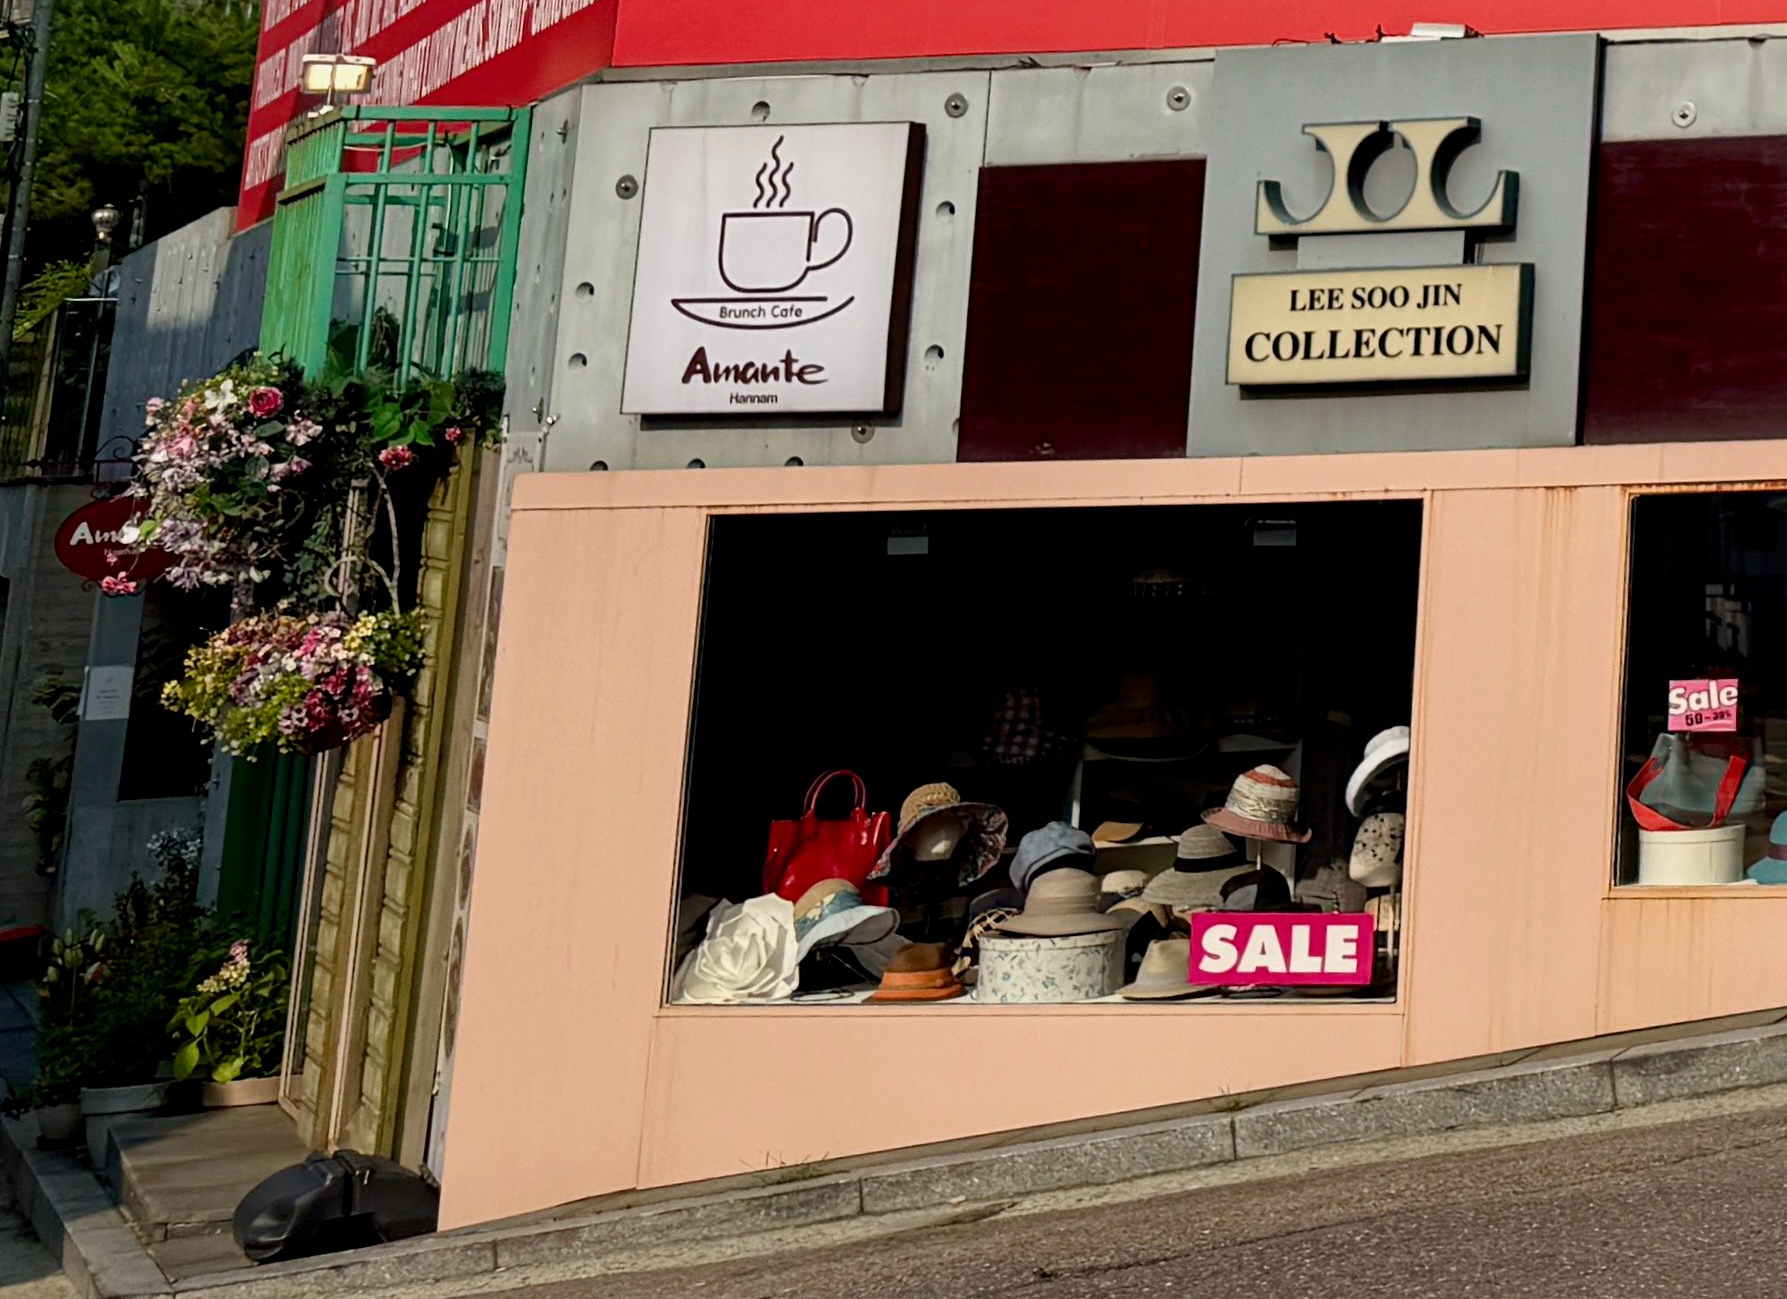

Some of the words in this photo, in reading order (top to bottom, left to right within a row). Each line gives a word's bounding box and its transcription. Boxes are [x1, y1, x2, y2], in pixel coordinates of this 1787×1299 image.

[719, 304, 766, 320] Brunch
[771, 303, 803, 319] Cafe
[1289, 288, 1345, 312] LEE
[1350, 285, 1410, 310] SOO
[1415, 283, 1463, 309] JIN
[1244, 323, 1504, 363] COLLECTION
[681, 346, 829, 385] Amante
[729, 392, 778, 406] Hannam
[1668, 680, 1738, 715] Sale
[1199, 924, 1358, 974] SALE
